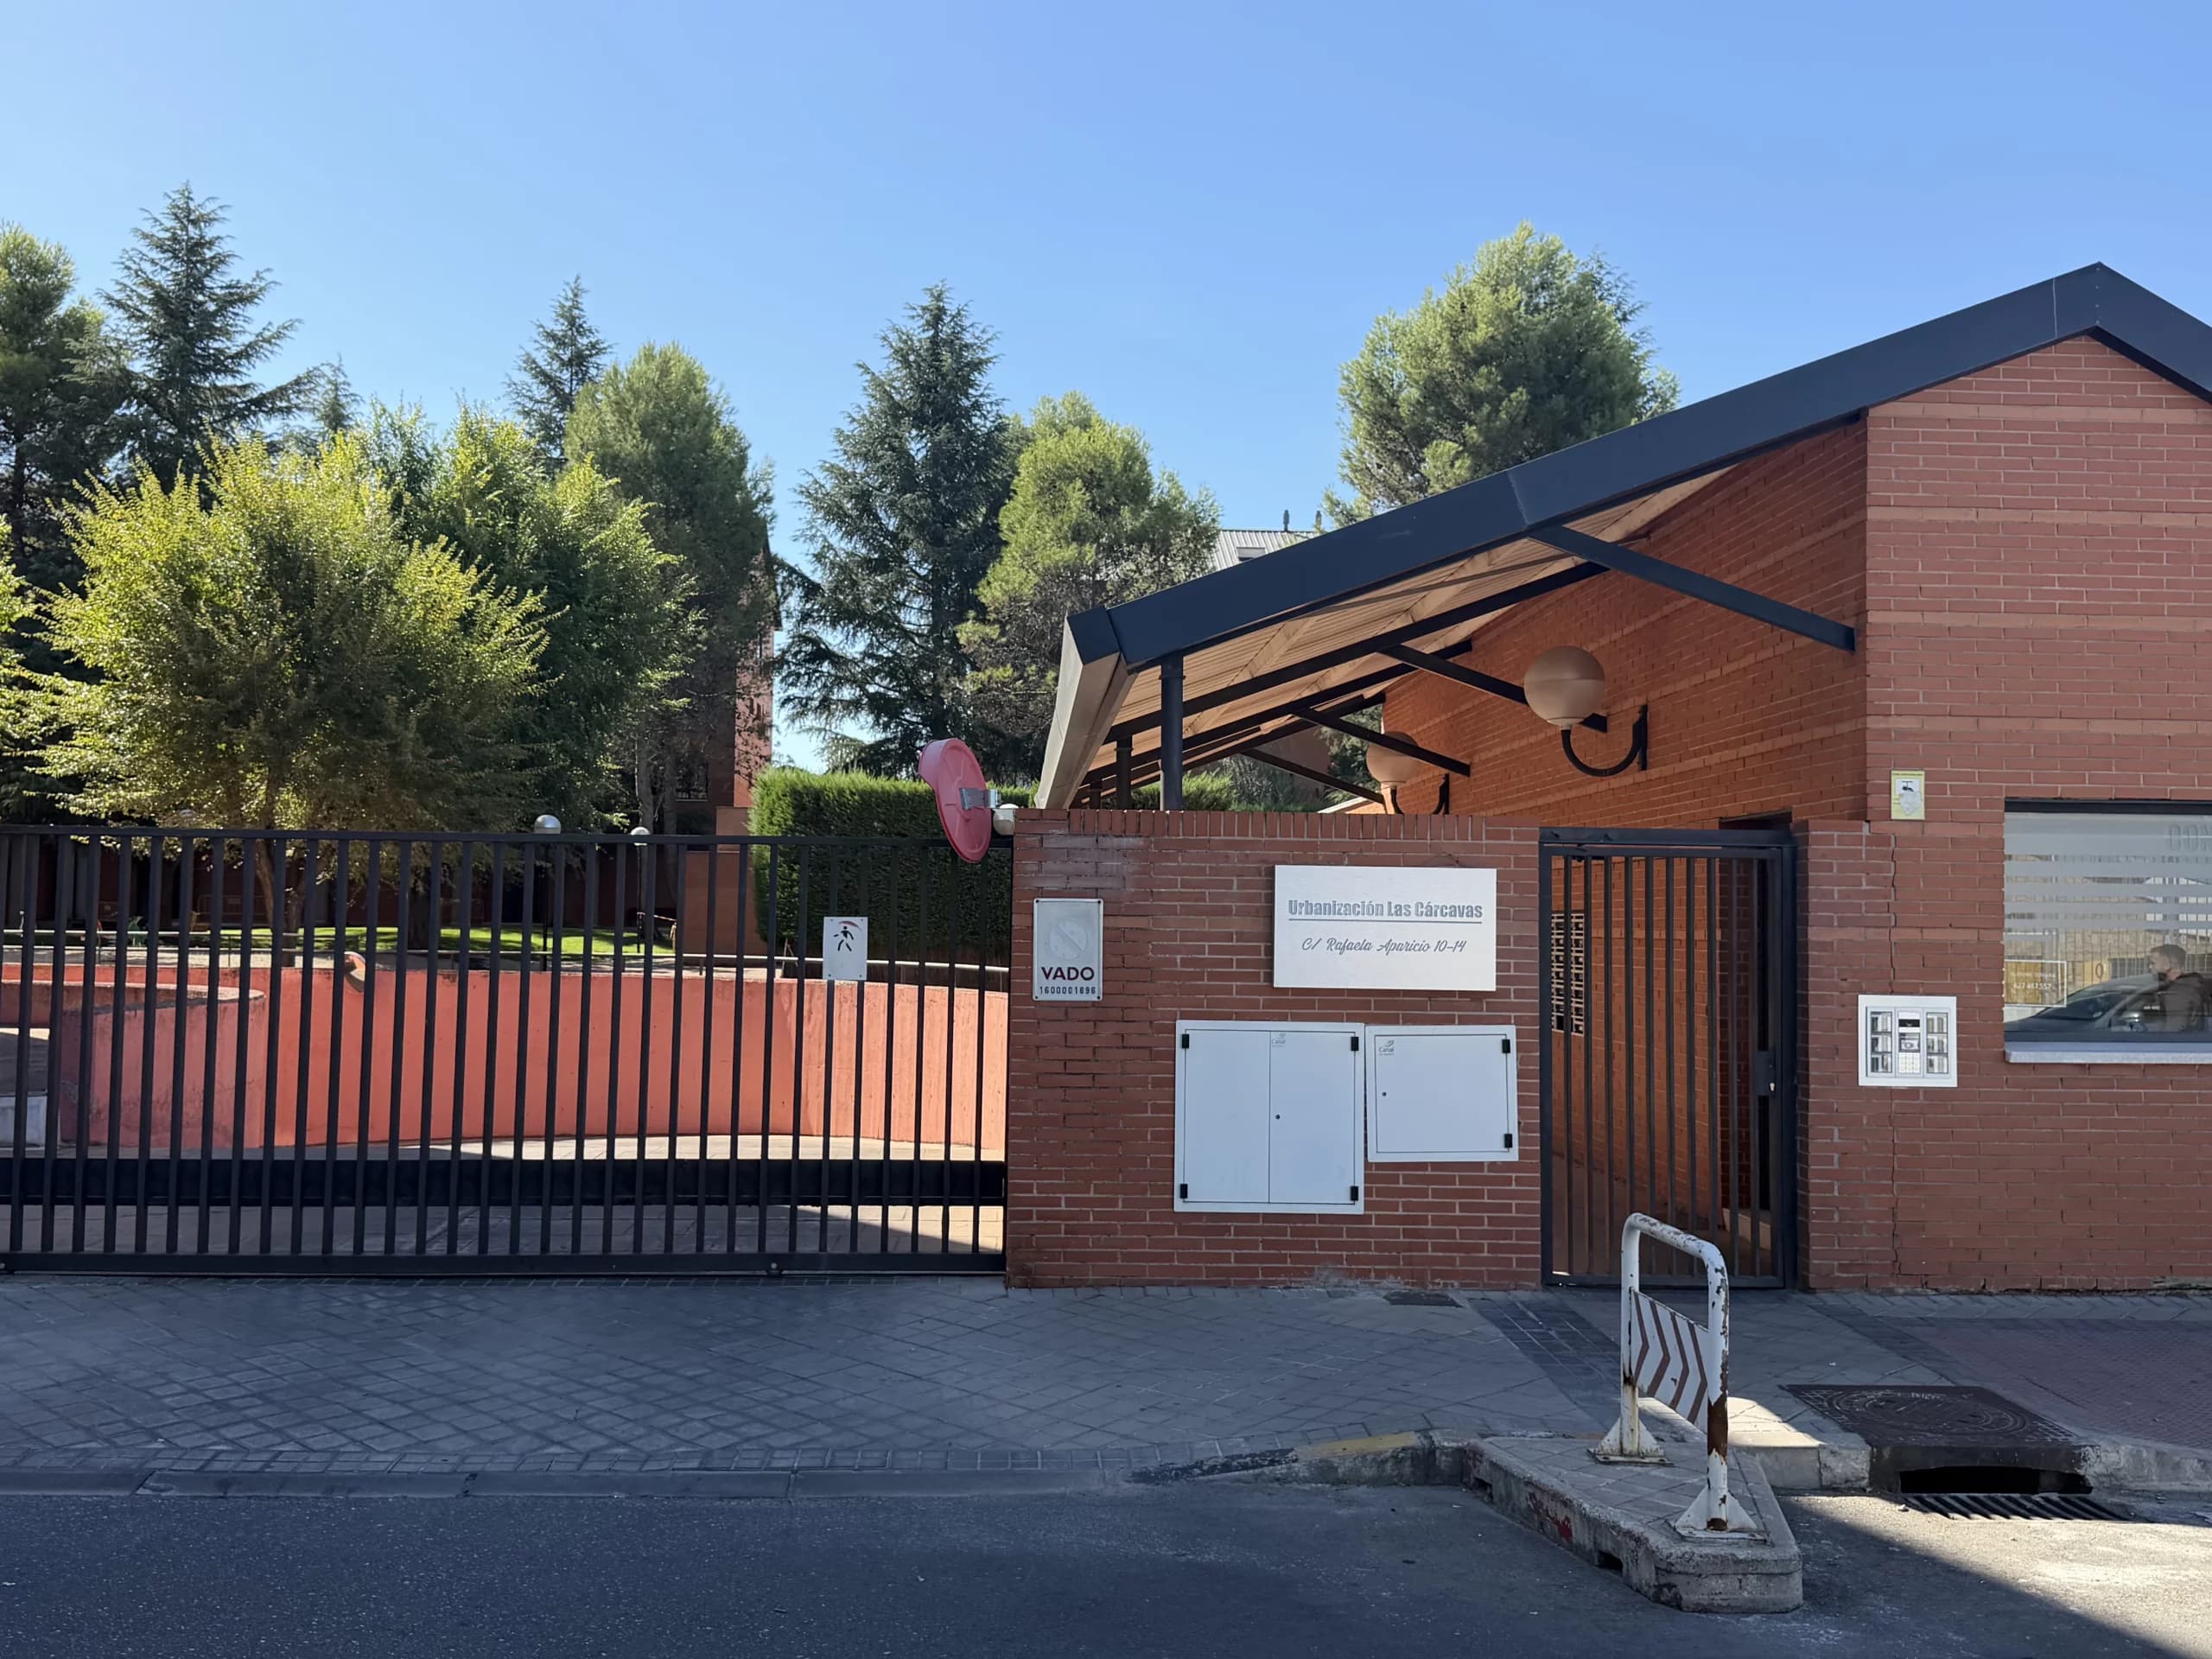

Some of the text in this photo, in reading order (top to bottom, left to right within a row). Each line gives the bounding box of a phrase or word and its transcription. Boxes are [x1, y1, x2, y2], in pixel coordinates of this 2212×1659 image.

[1288, 899, 1483, 918] Urbanización Las Cárcavas
[1302, 938, 1466, 957] C/ Rafaela Aparicio 10-14
[1041, 967, 1095, 981] VADO
